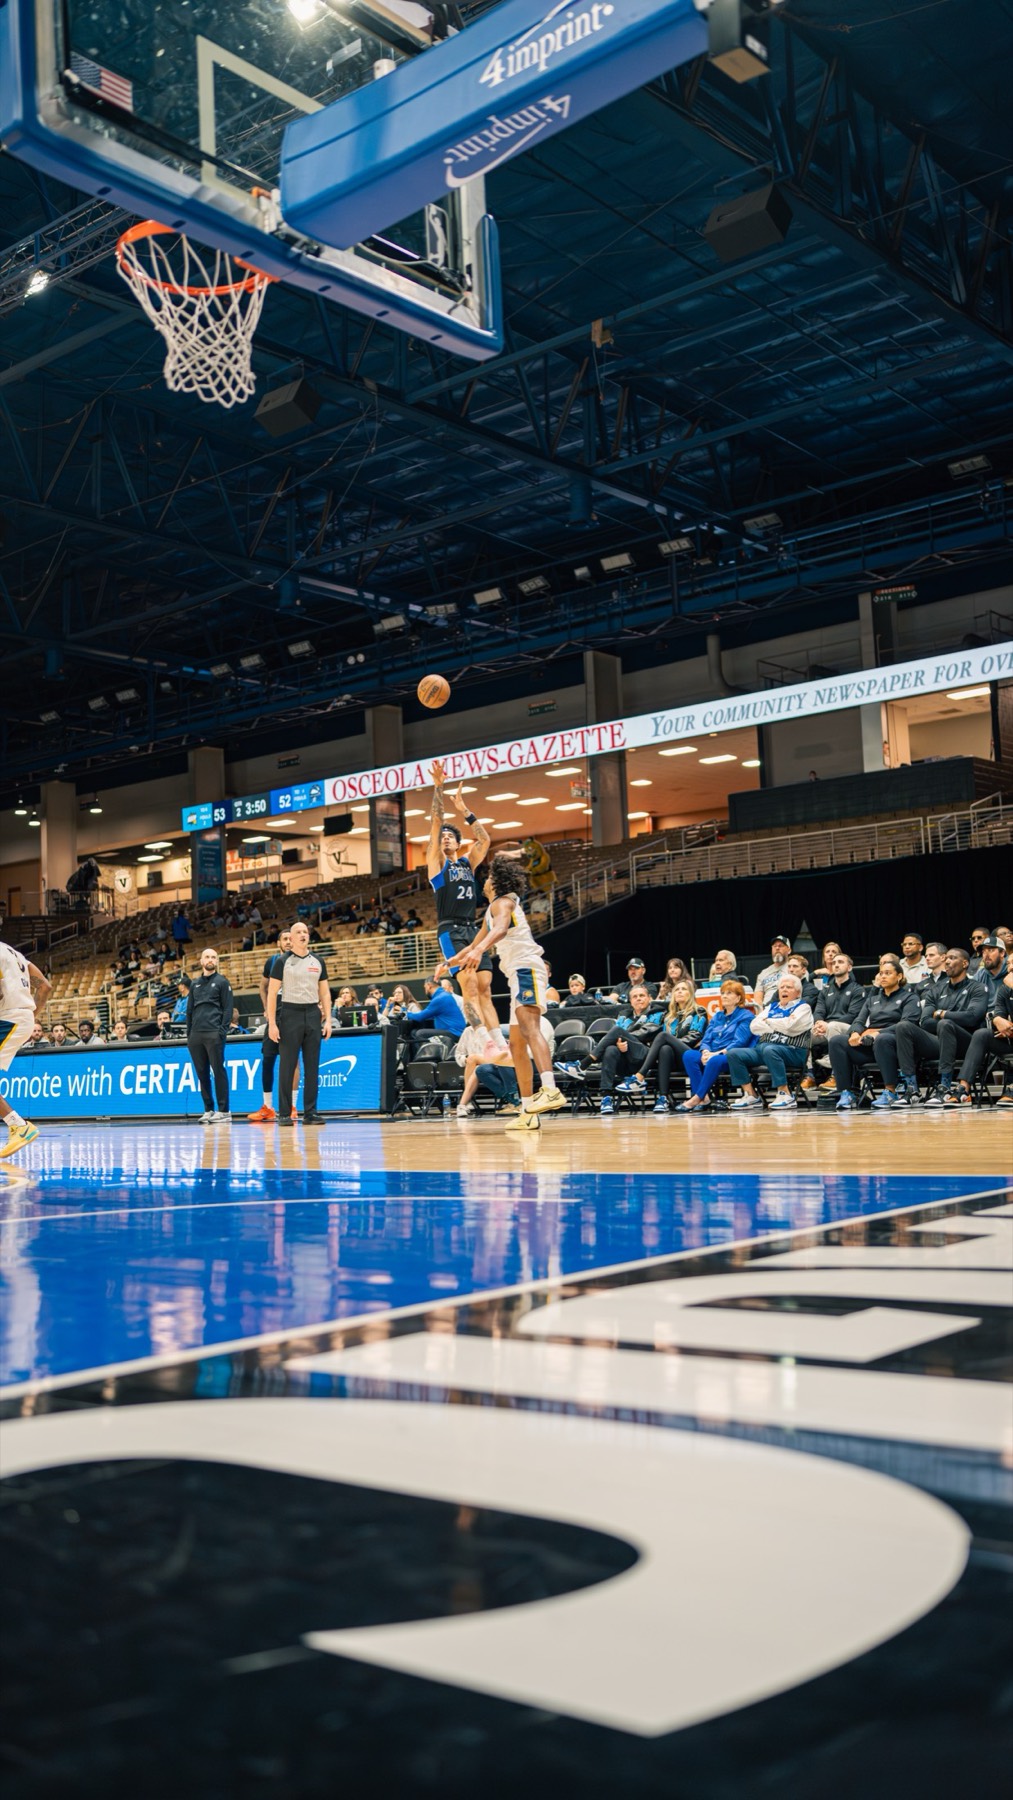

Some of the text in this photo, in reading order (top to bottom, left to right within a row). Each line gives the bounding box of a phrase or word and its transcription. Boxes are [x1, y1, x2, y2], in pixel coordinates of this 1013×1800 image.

[478, 3, 606, 88] 4imprint
[443, 94, 571, 162] 4imprint
[702, 692, 808, 728] COMMUNITY
[813, 669, 926, 707] NEWSPAPER
[933, 660, 973, 684] FOR
[332, 763, 427, 802] OSCEOLA
[236, 807, 242, 817] 2
[245, 799, 267, 816] 3:50
[278, 794, 292, 809] 52
[213, 807, 226, 822] 53
[456, 885, 474, 900] 24
[67, 1065, 113, 1097] with
[119, 1058, 262, 1096] CERTATY
[317, 1069, 344, 1093] print
